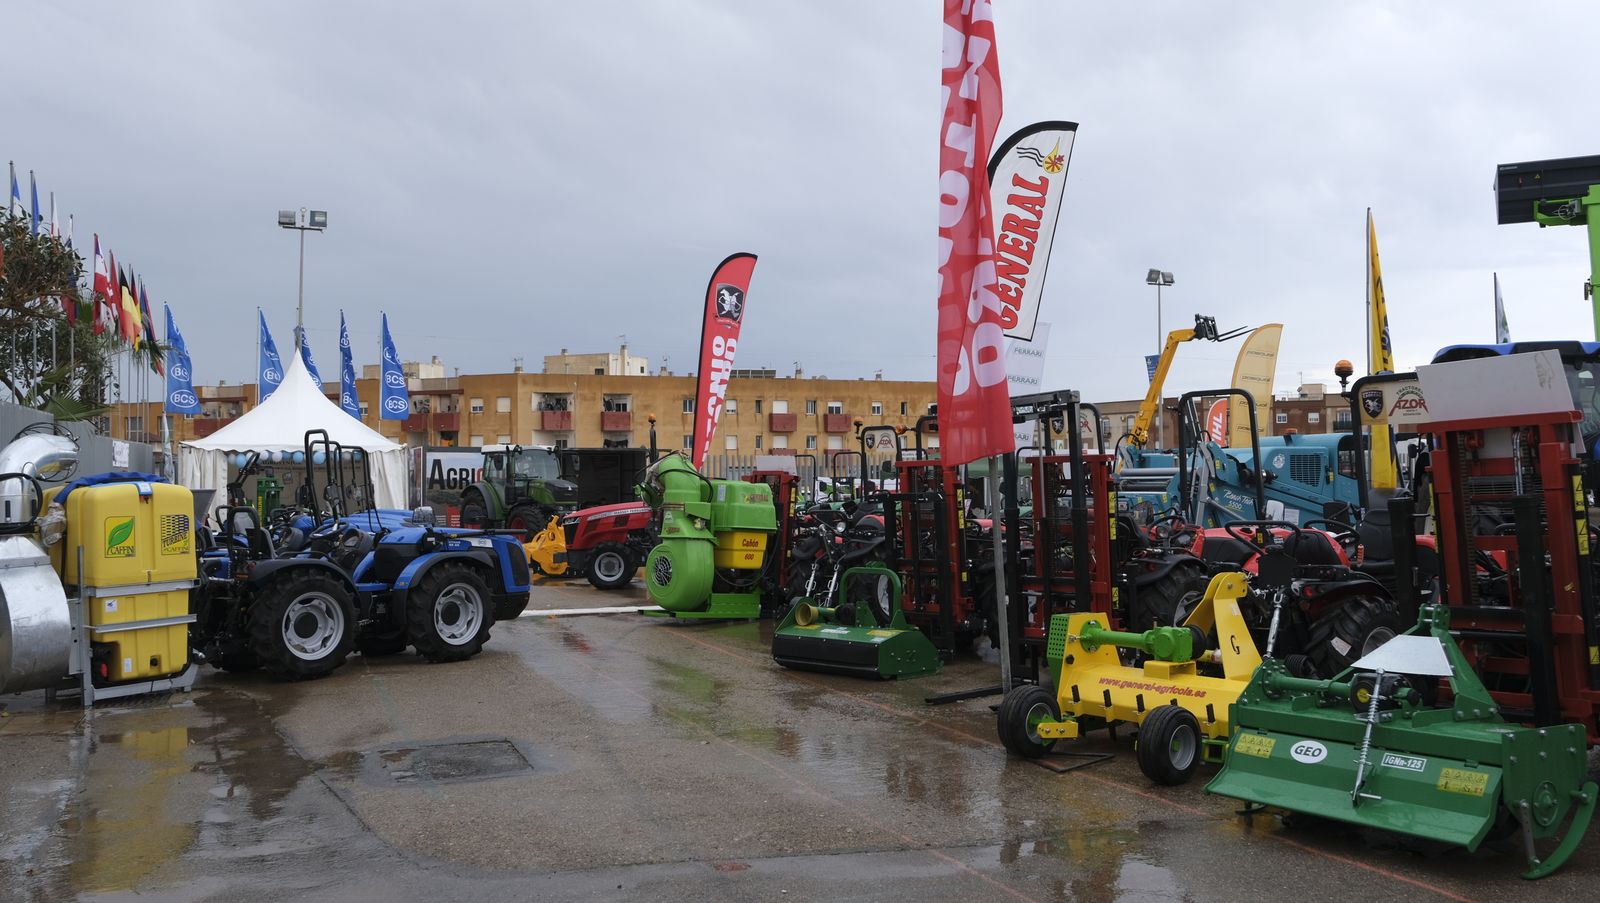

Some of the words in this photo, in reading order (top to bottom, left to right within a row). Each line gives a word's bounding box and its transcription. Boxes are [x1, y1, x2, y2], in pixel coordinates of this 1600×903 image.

[996, 172, 1049, 331] GENERAL
[1014, 347, 1043, 357] FERRARI
[1007, 375, 1039, 386] FERRARI
[174, 394, 195, 404] BCS
[388, 402, 405, 410] BCS
[1388, 398, 1430, 417] AZOR
[744, 552, 755, 561] 600
[1098, 676, 1207, 699] www.general-agricola.es
[1294, 744, 1323, 758] GEO
